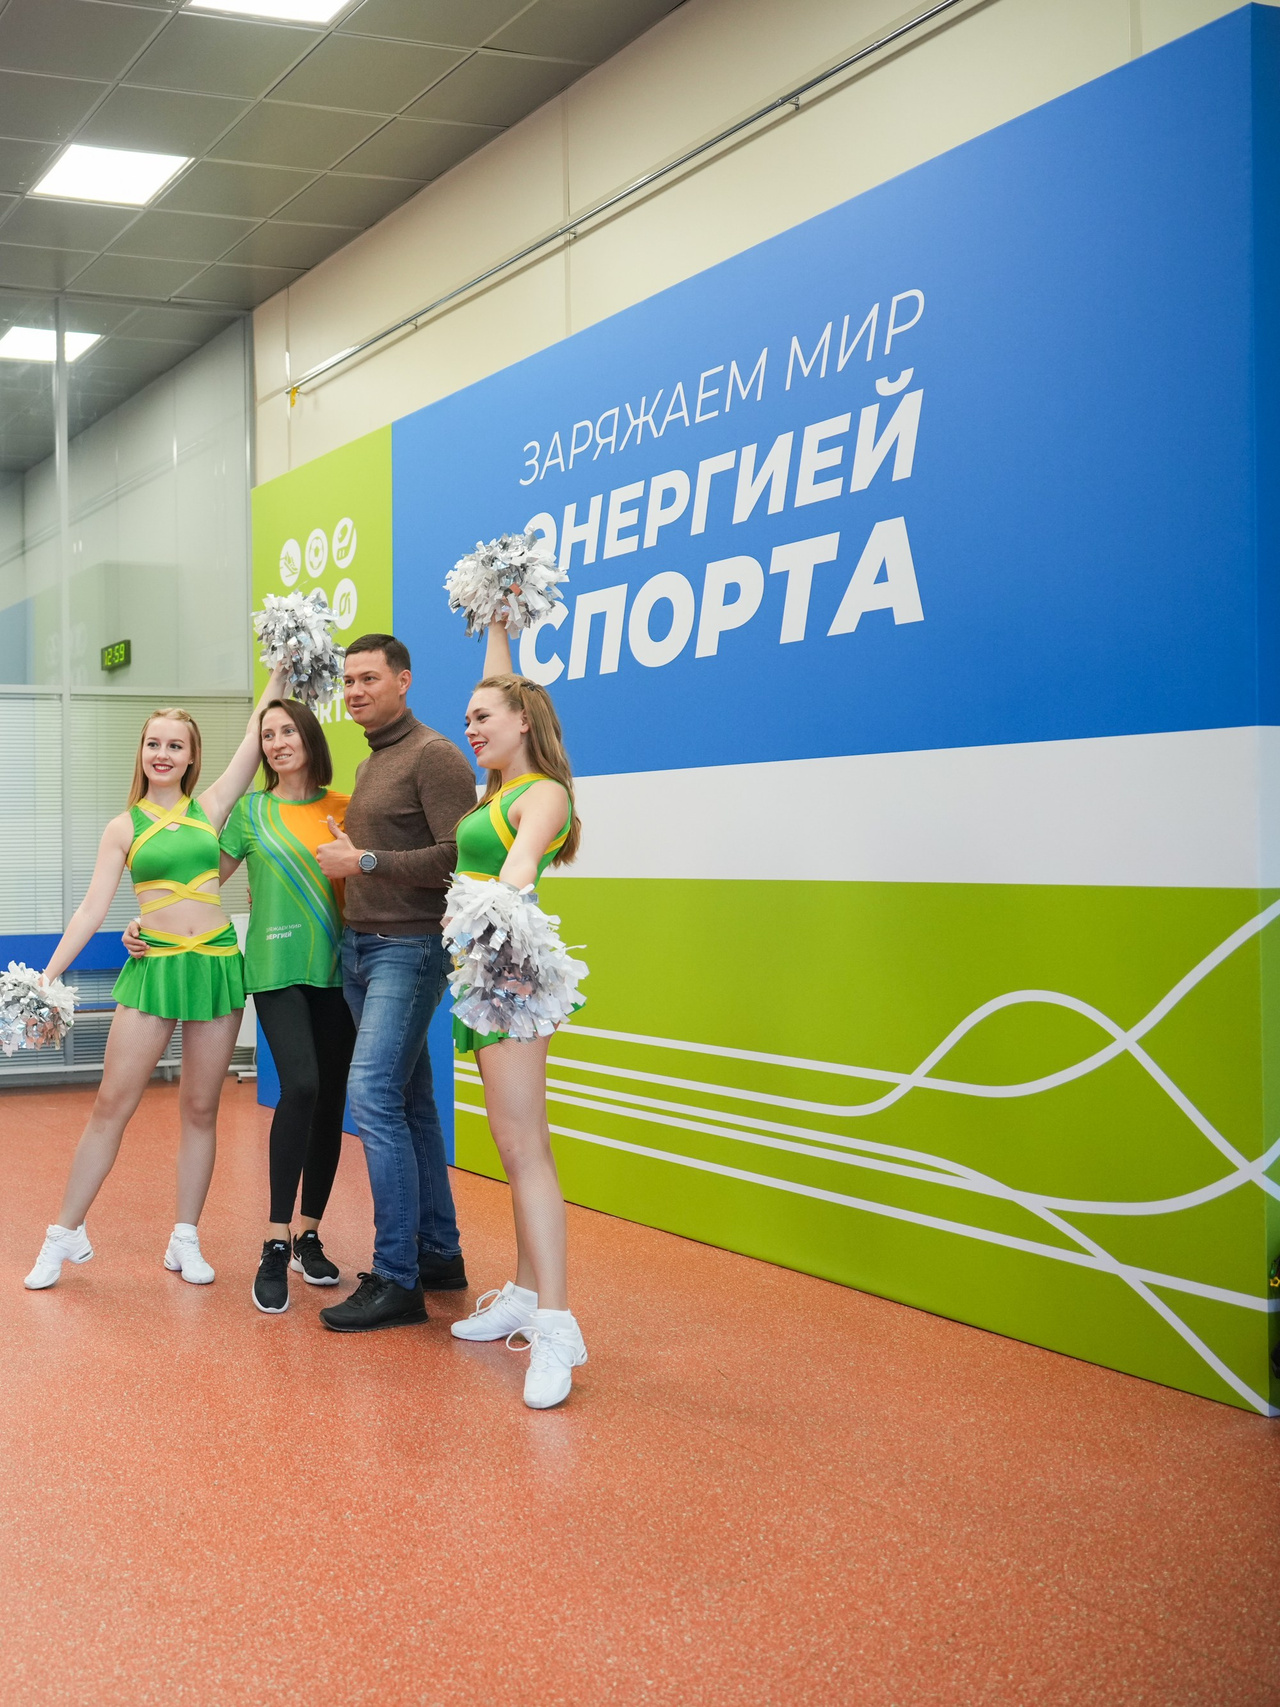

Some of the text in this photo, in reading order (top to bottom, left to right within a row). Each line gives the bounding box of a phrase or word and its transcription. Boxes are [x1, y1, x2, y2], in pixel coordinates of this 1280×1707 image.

[519, 289, 925, 486] ЗАРЯЖАЕМ МИР
[519, 516, 925, 687] СПОРТА
